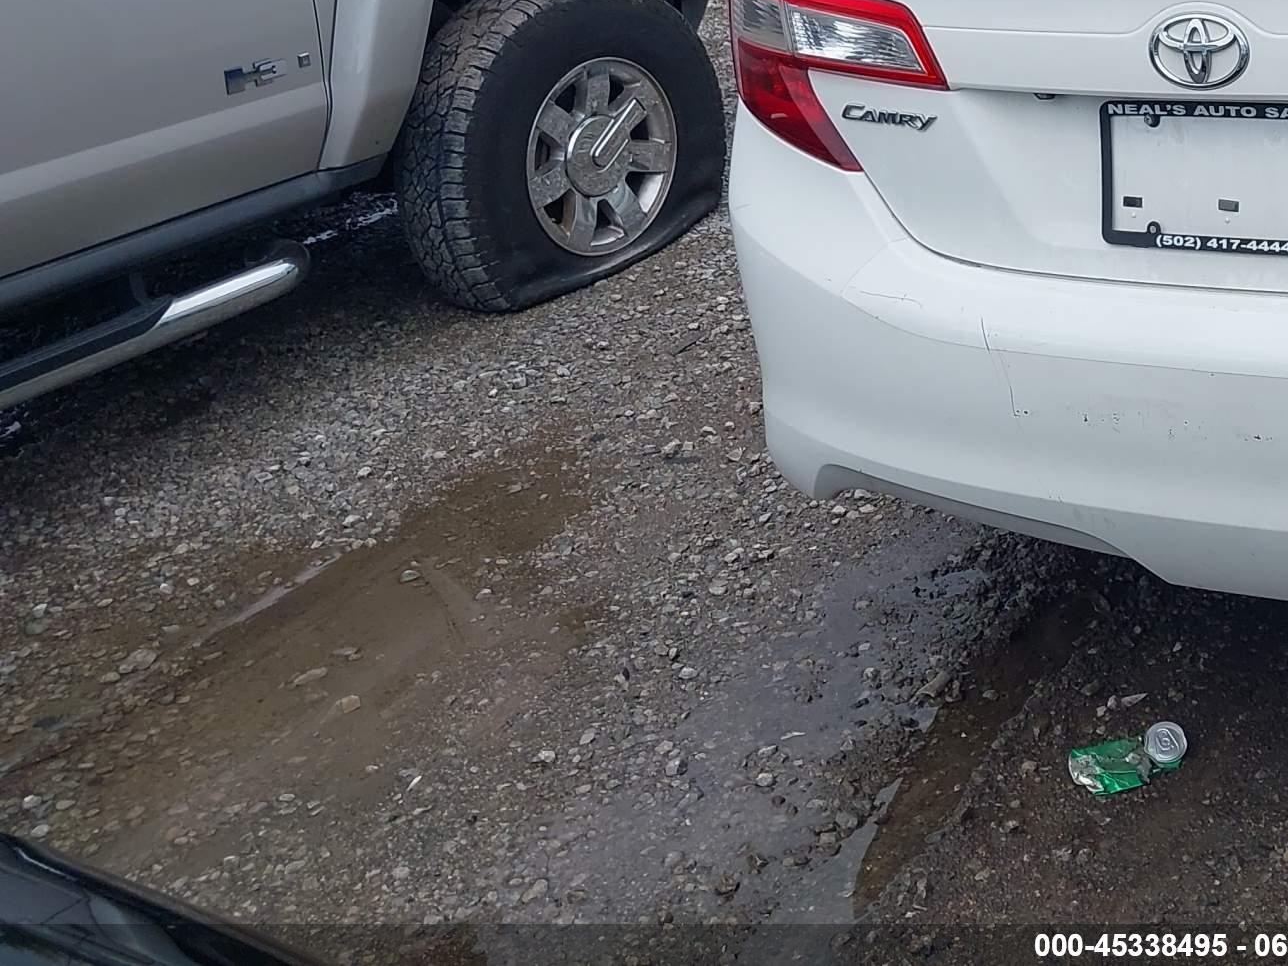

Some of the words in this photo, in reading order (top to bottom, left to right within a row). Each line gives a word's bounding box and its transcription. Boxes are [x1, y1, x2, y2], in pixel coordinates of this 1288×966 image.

[1107, 104, 1186, 117] NEAL'S
[1193, 105, 1257, 118] AUTO
[1156, 235, 1202, 250] (502)
